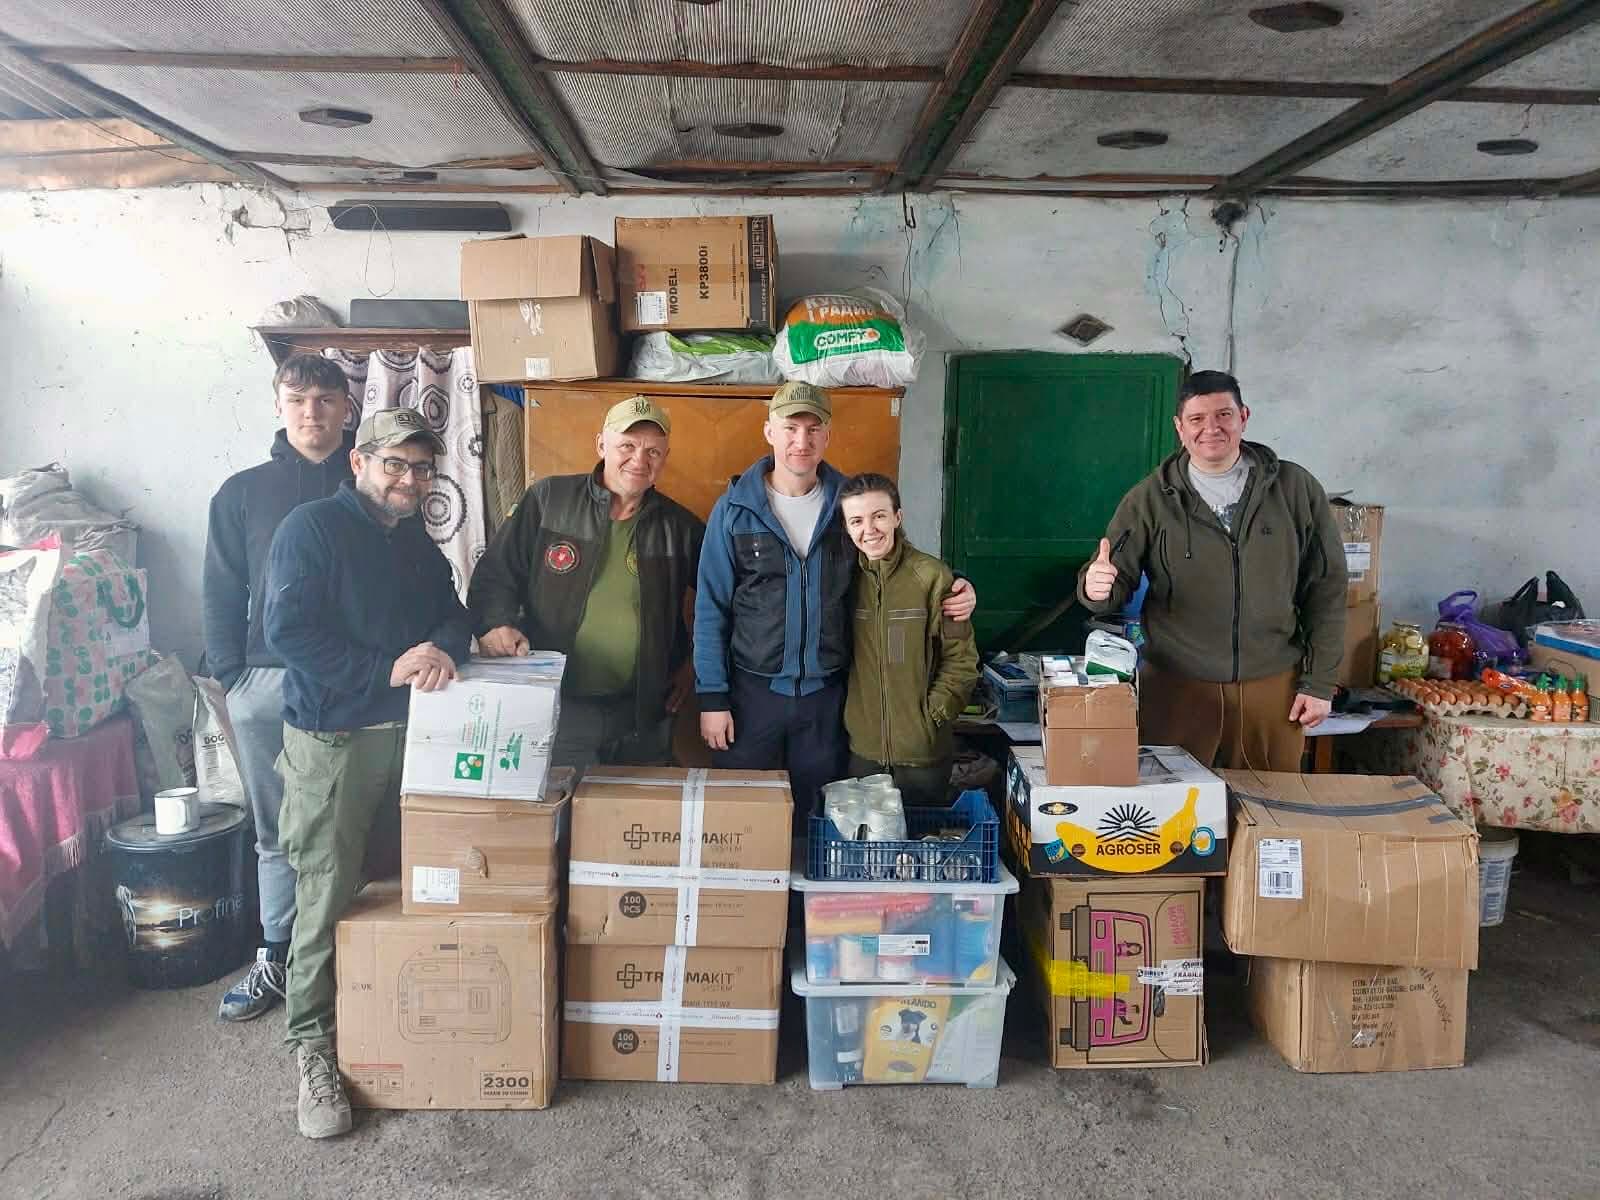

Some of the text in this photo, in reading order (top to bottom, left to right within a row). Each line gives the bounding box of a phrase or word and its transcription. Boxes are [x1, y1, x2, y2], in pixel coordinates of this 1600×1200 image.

[699, 245, 710, 300] KP3800i
[669, 268, 679, 314] MODEL:
[817, 330, 868, 348] COMFY
[652, 832, 744, 845] TRAAKIT
[1096, 843, 1160, 856] AGROSER
[624, 896, 641, 904] 100
[644, 970, 735, 984] TRMAKIT
[617, 1032, 634, 1041] 100
[483, 1076, 529, 1088] 2300
